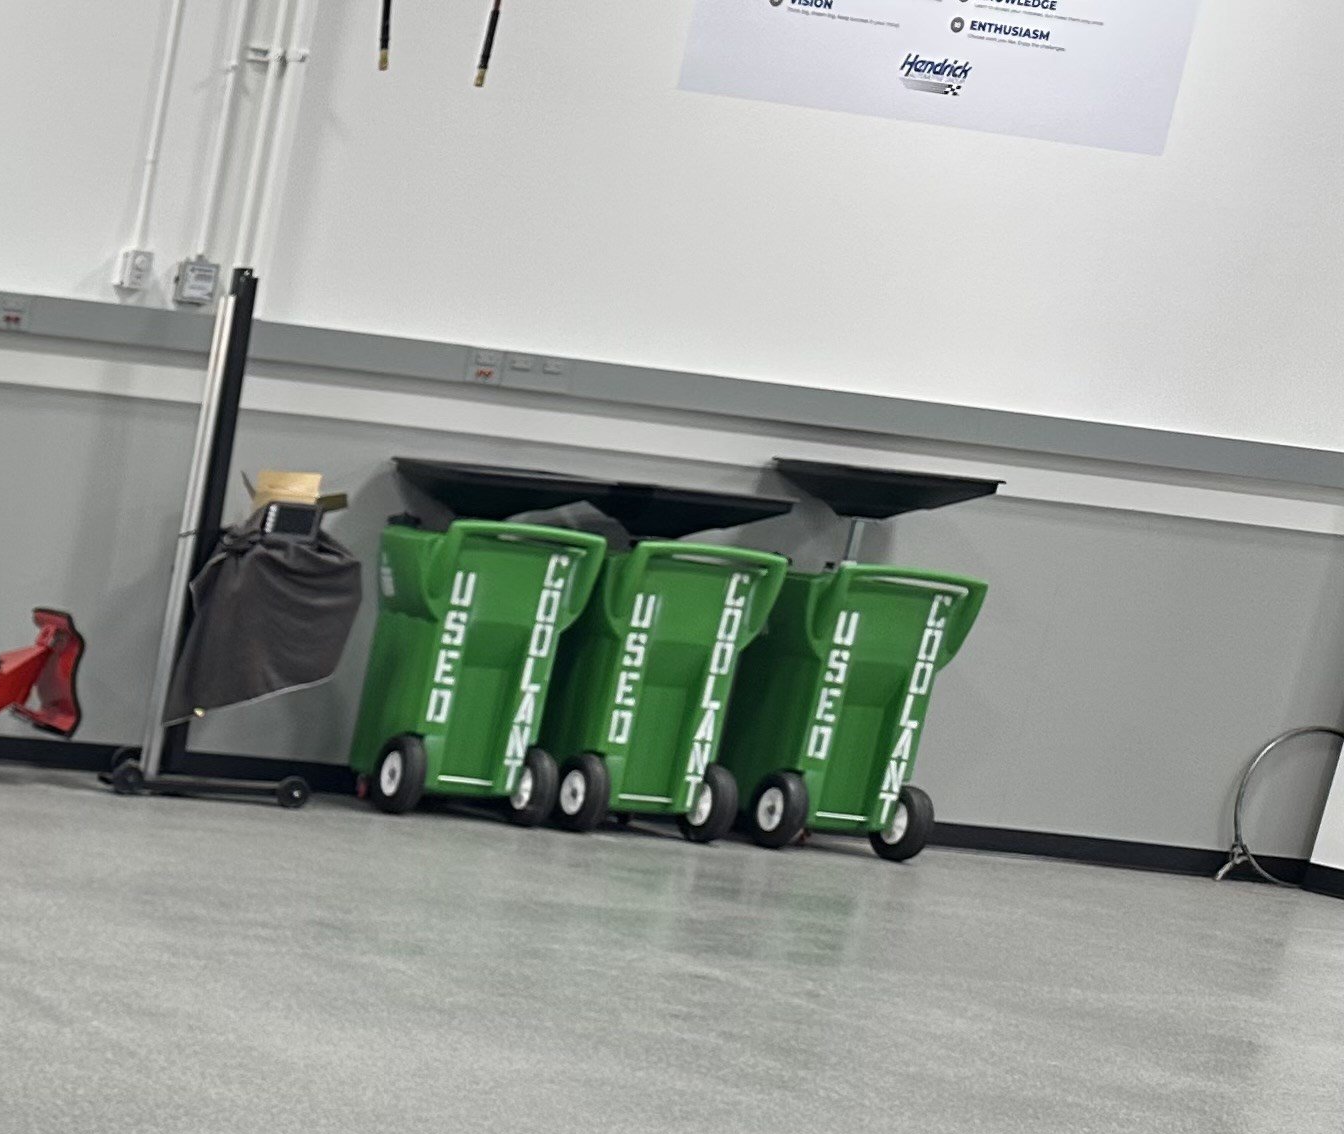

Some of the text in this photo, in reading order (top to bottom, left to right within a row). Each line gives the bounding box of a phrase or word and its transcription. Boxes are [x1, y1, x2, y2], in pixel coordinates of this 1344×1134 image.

[899, 53, 972, 79] Hendrick
[969, 20, 1050, 41] ENTHUSIASM
[426, 571, 476, 723] USED
[504, 554, 570, 792] COOLANT
[608, 593, 657, 744] USED
[685, 572, 750, 809] COOLANT
[808, 611, 860, 760] USED
[879, 594, 952, 824] COOLANT
